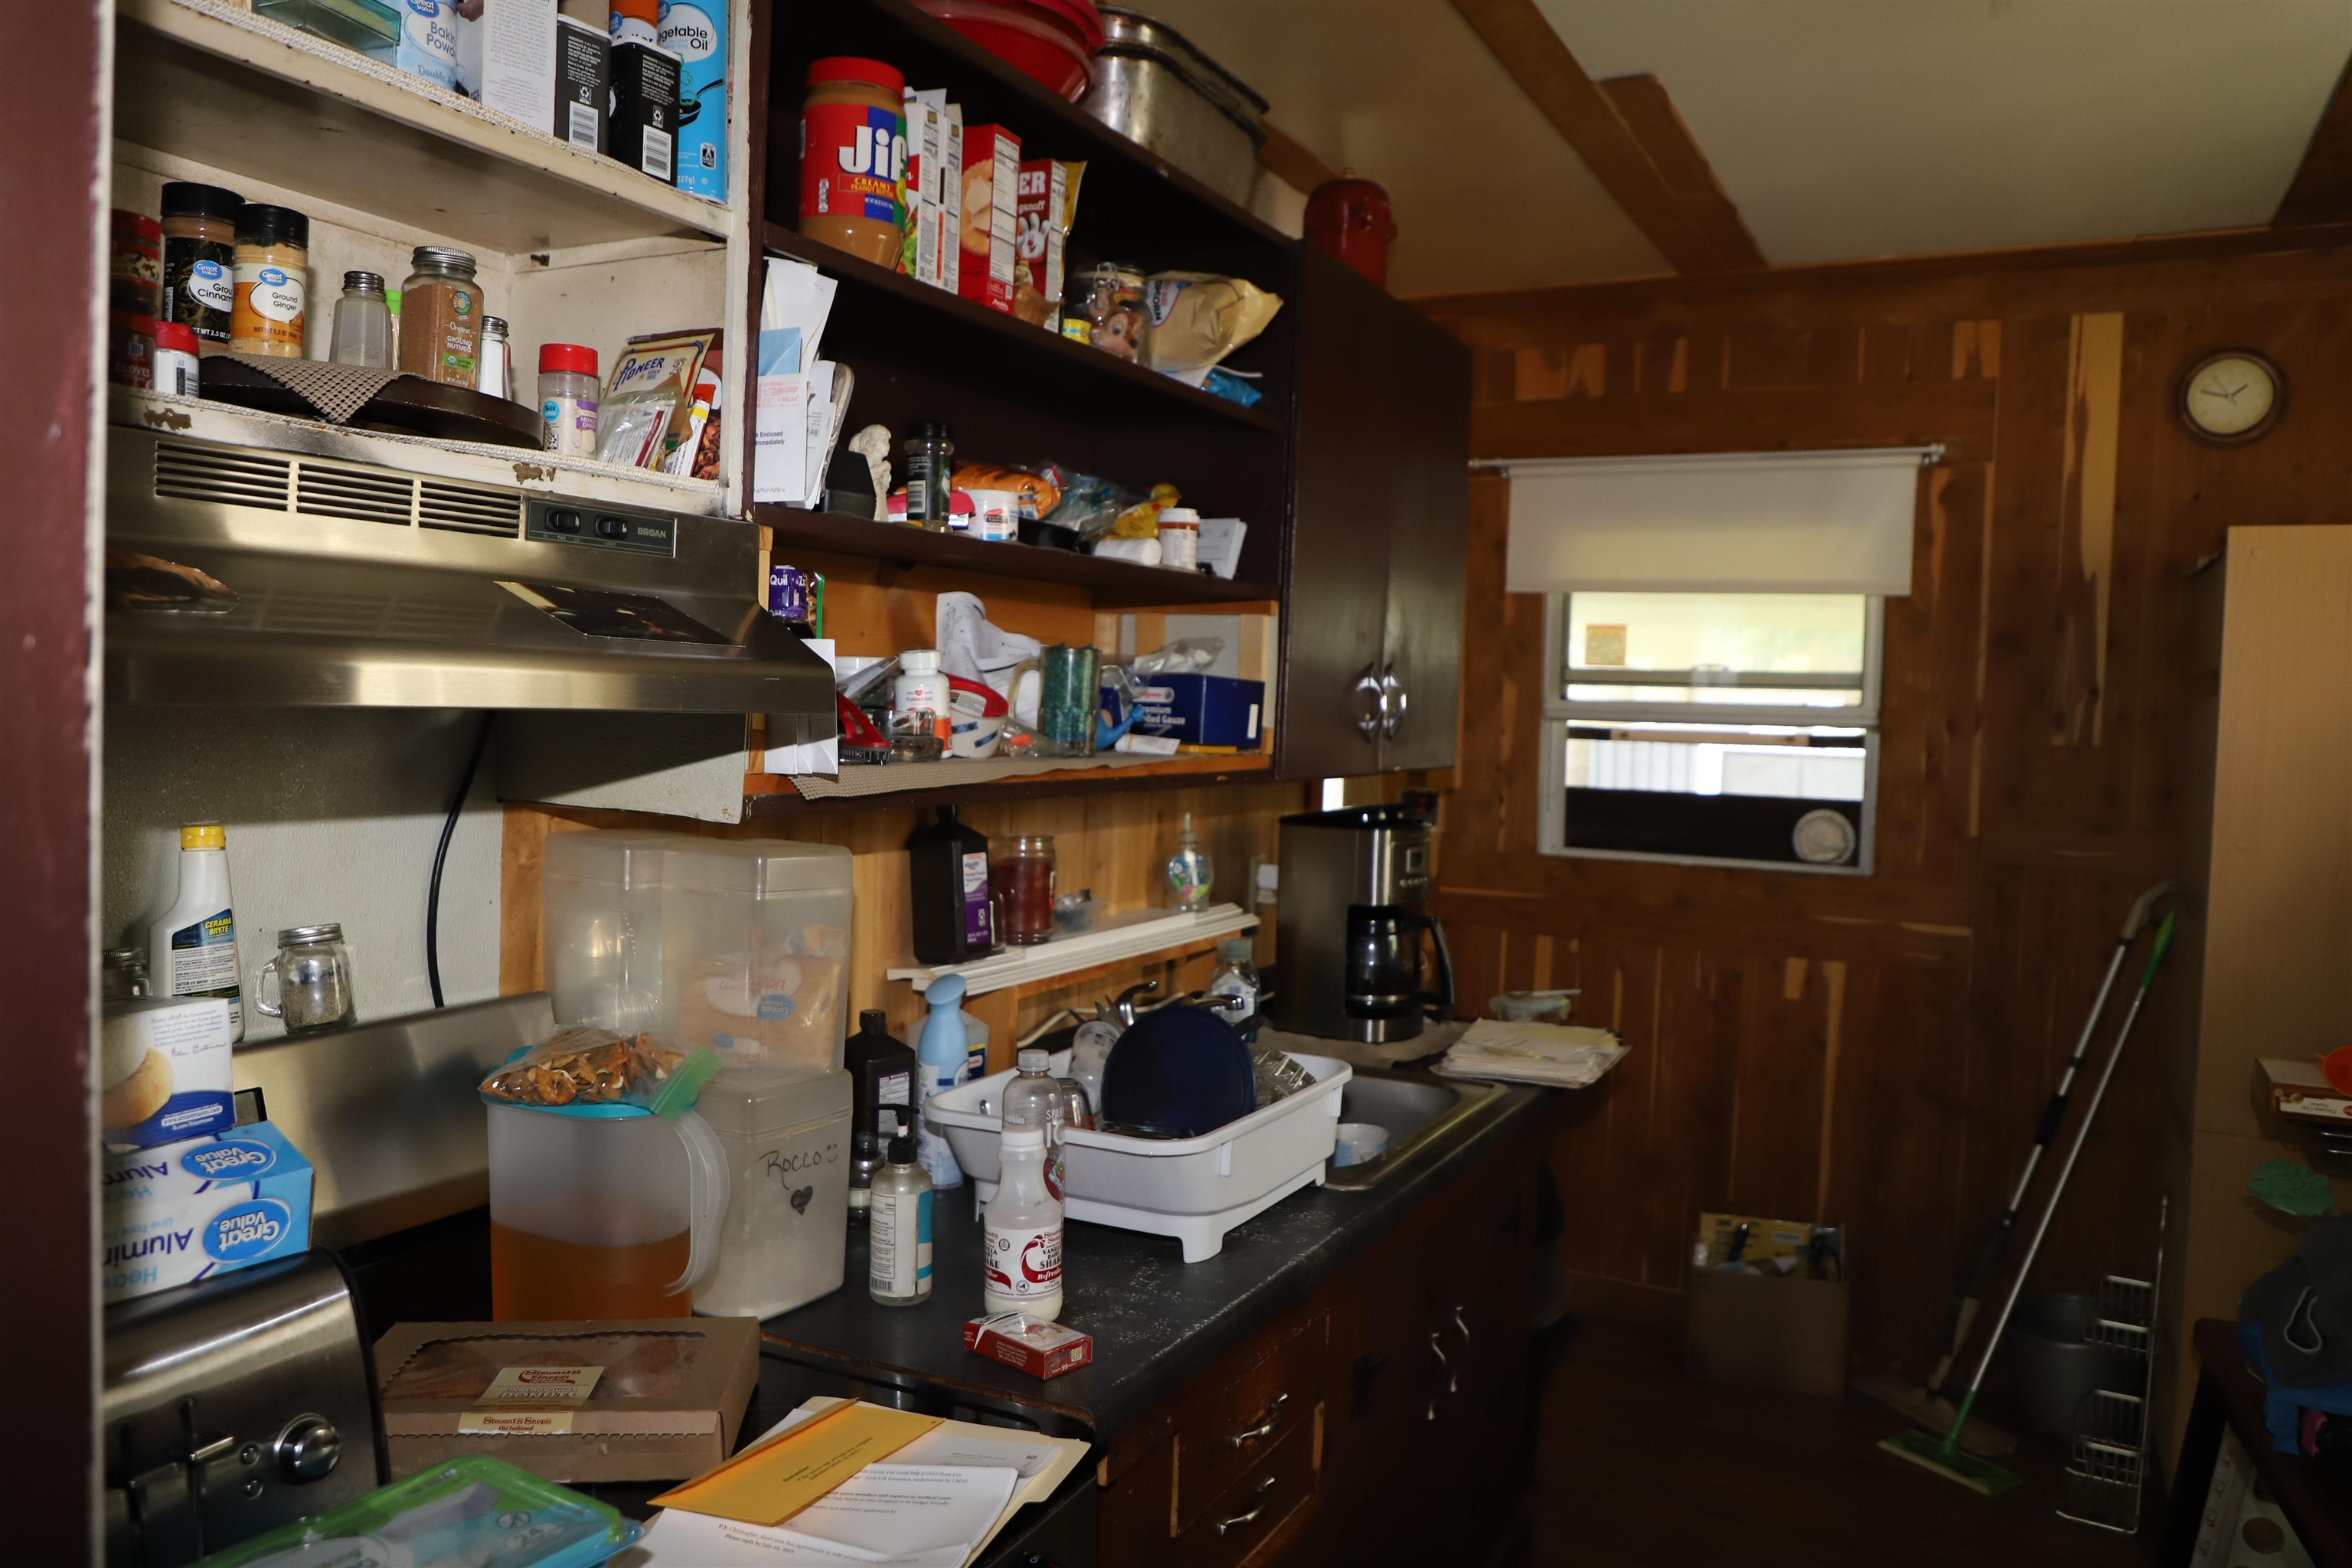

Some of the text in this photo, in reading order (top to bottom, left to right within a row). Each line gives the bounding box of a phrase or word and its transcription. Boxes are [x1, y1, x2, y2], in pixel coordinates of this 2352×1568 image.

[691, 38, 707, 51] Oil
[838, 125, 907, 182] Jif
[854, 177, 891, 191] CREAMY
[1018, 171, 1046, 195] ER
[851, 183, 893, 198] PEANUT BUTTER
[197, 263, 217, 273] Great
[263, 272, 282, 280] Great
[272, 292, 298, 303] Ground
[273, 300, 297, 311] Ginger
[447, 335, 472, 347] GROUND
[447, 341, 472, 353] NUTMEG
[613, 358, 665, 391] PIONEER
[637, 527, 667, 538] BROAN
[770, 574, 788, 586] Quil
[205, 917, 232, 929] CERAMA
[209, 926, 229, 936] BRYTE
[195, 1147, 246, 1162] Value
[200, 1151, 267, 1174] Great
[220, 1210, 266, 1231] Value
[219, 1220, 280, 1252] Great
[795, 1544, 825, 1553] opportunity
